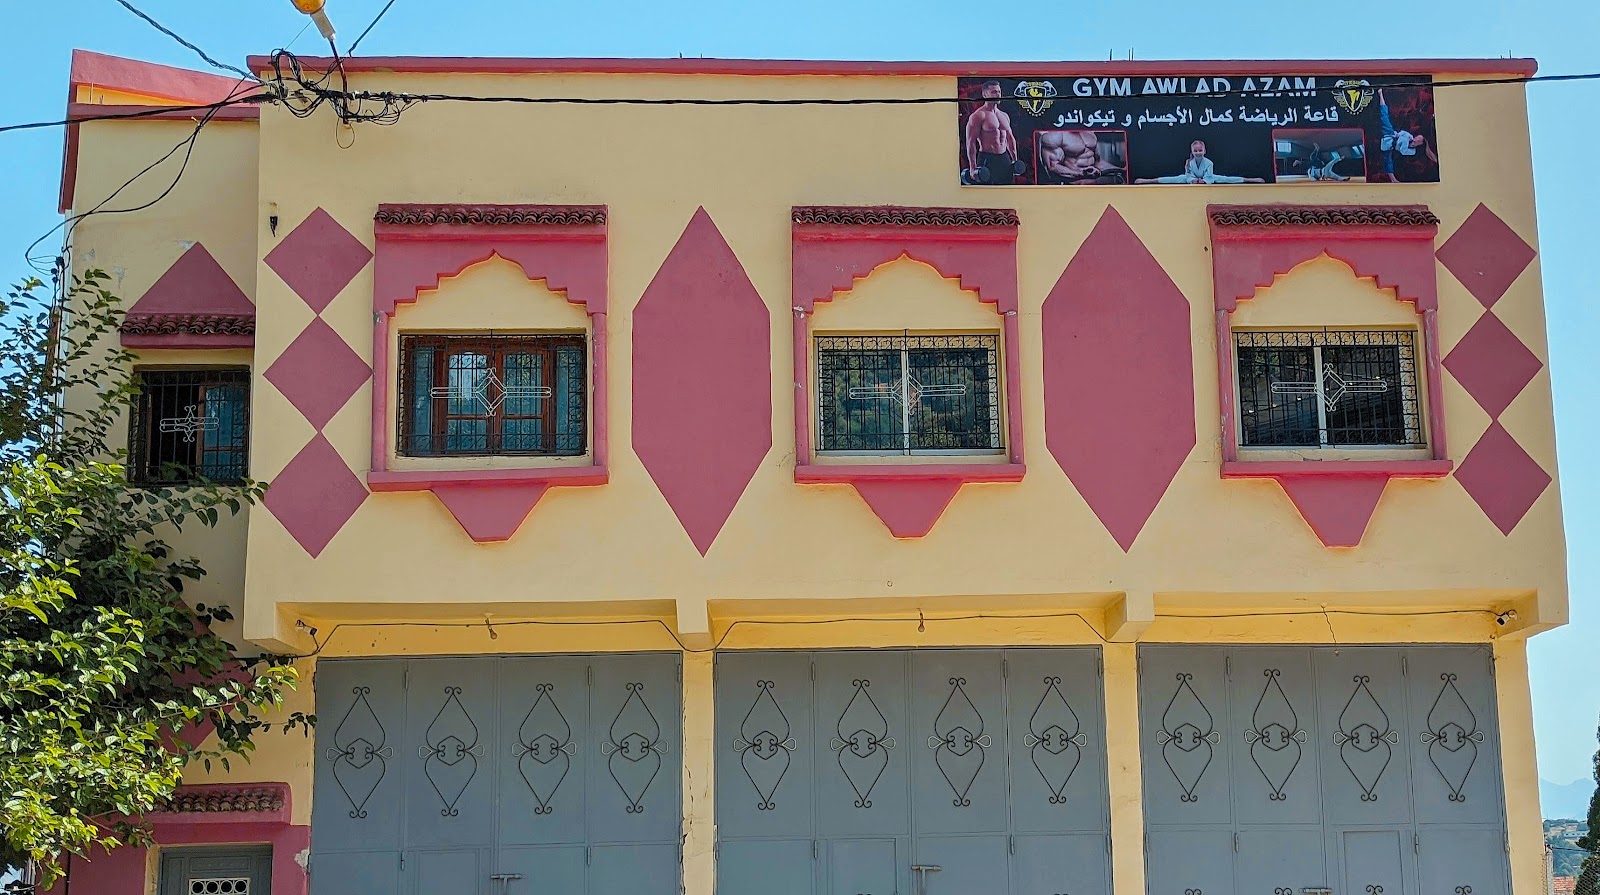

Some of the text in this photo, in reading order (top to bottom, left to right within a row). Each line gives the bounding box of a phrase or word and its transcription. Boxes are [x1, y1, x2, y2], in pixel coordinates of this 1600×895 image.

[1072, 77, 1132, 97] GYM
[1240, 77, 1317, 97] AZAM
[1053, 105, 1339, 130] قاعة الرياضة كمال الأجسام و تيكواندو
